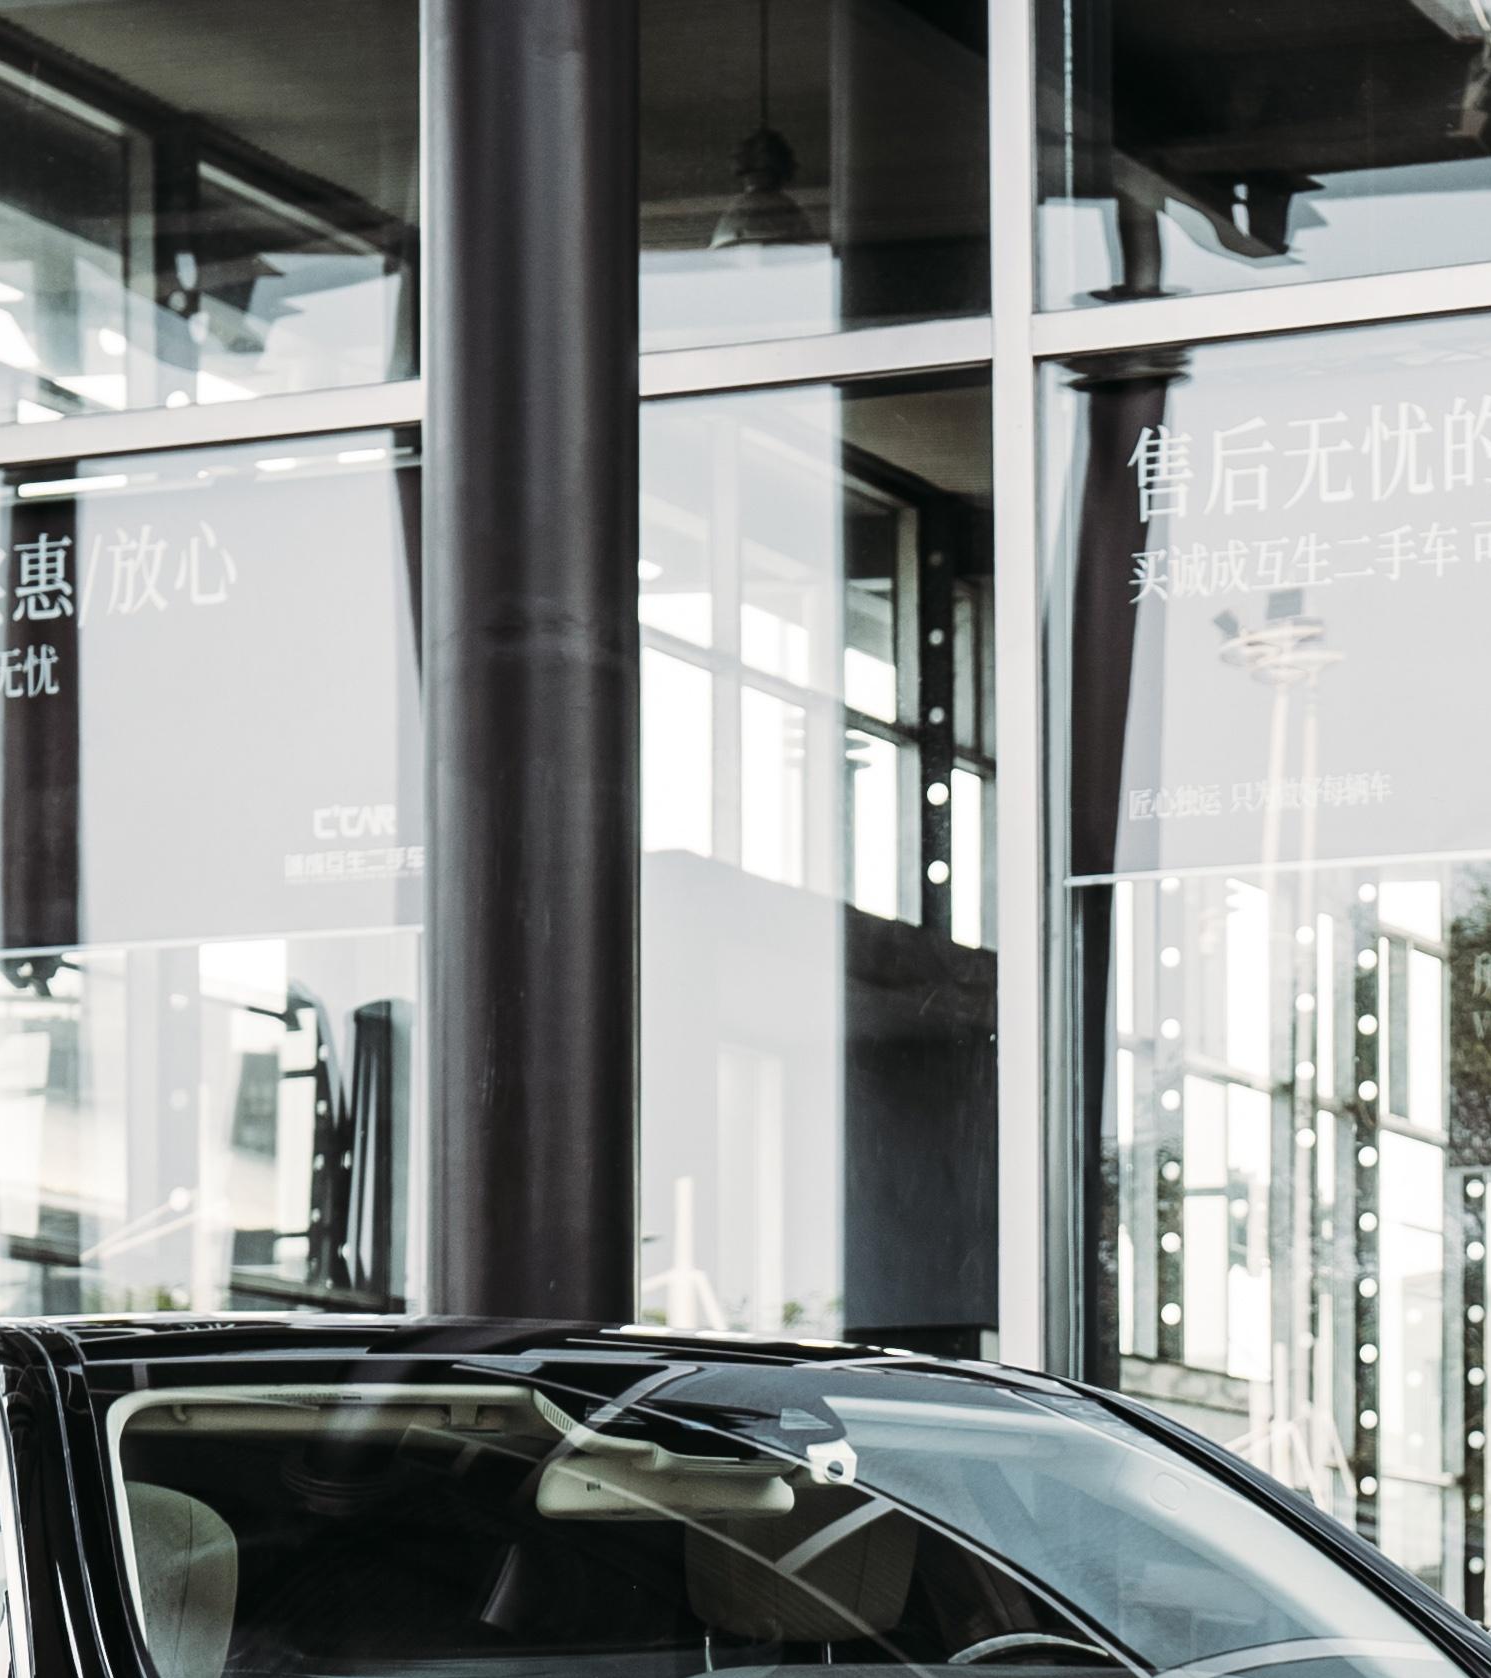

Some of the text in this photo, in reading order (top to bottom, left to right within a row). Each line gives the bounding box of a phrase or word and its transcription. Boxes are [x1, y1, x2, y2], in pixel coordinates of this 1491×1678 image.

[1128, 520, 1461, 603] 买诚成互生二手车
